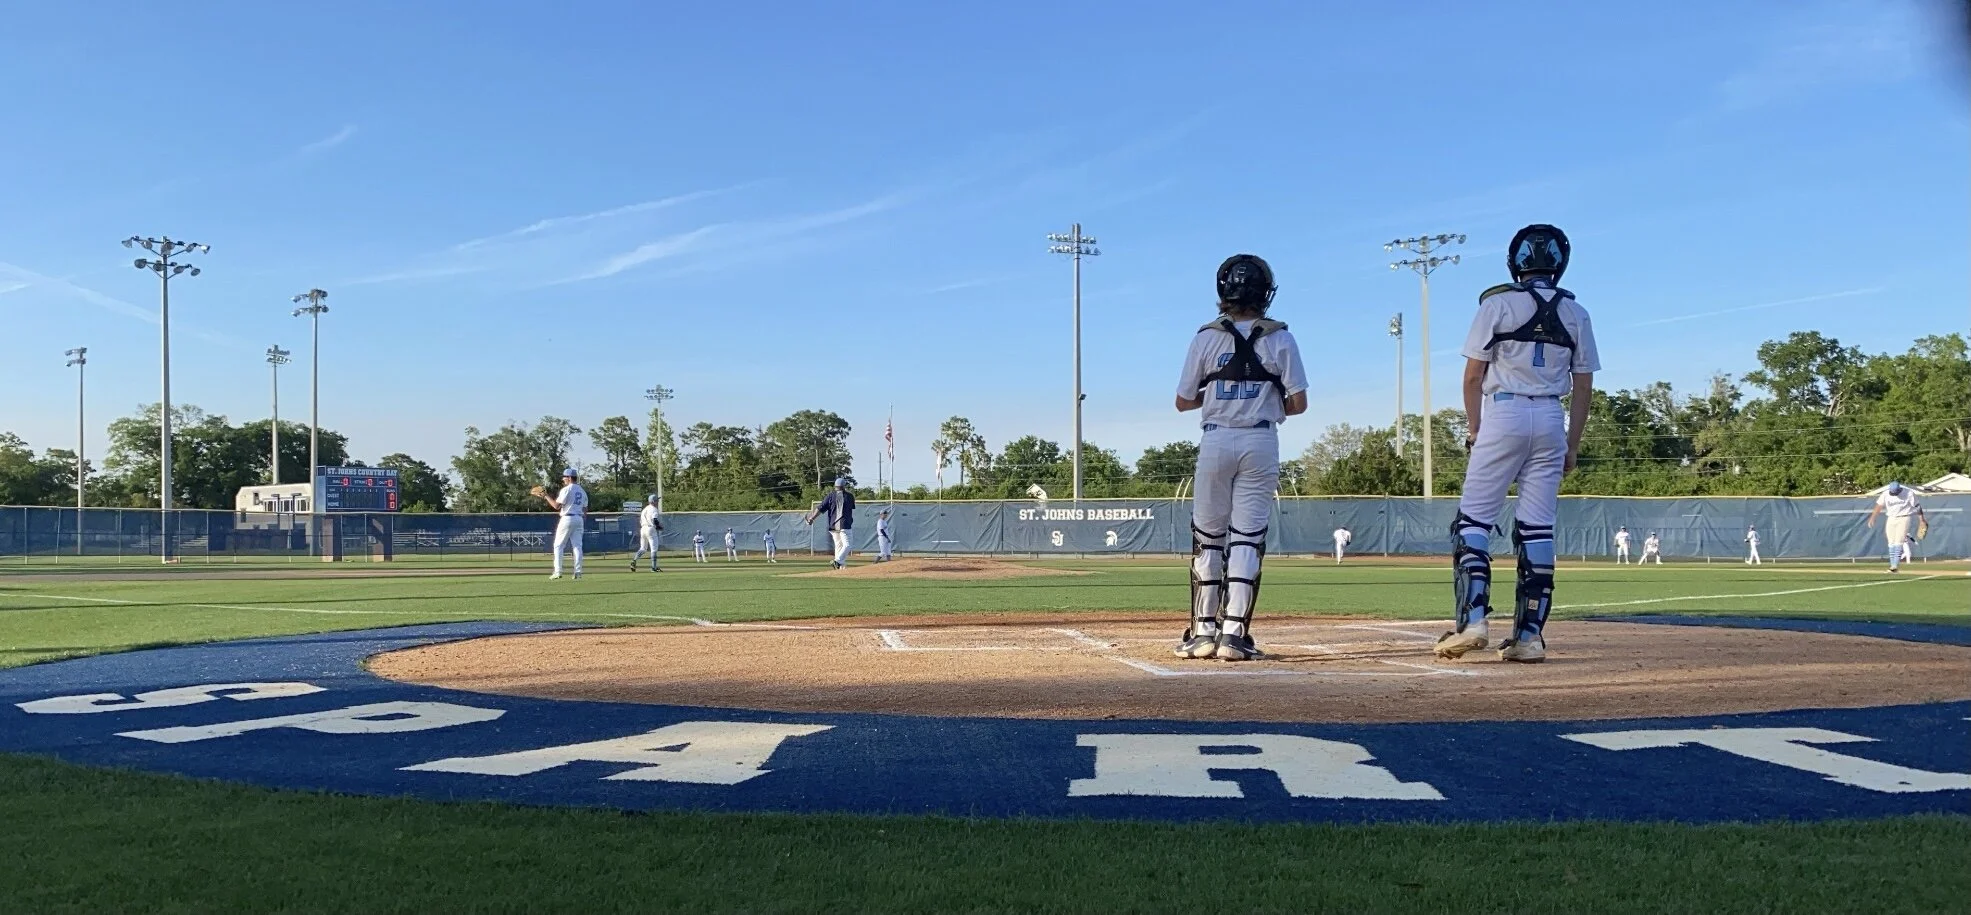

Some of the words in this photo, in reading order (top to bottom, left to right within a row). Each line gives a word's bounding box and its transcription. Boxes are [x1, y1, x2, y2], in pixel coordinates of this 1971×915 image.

[1019, 508, 1039, 521] ST.
[1042, 508, 1084, 521] JOHNS
[1087, 507, 1155, 521] BASEBALL
[14, 682, 1971, 801] SPART
